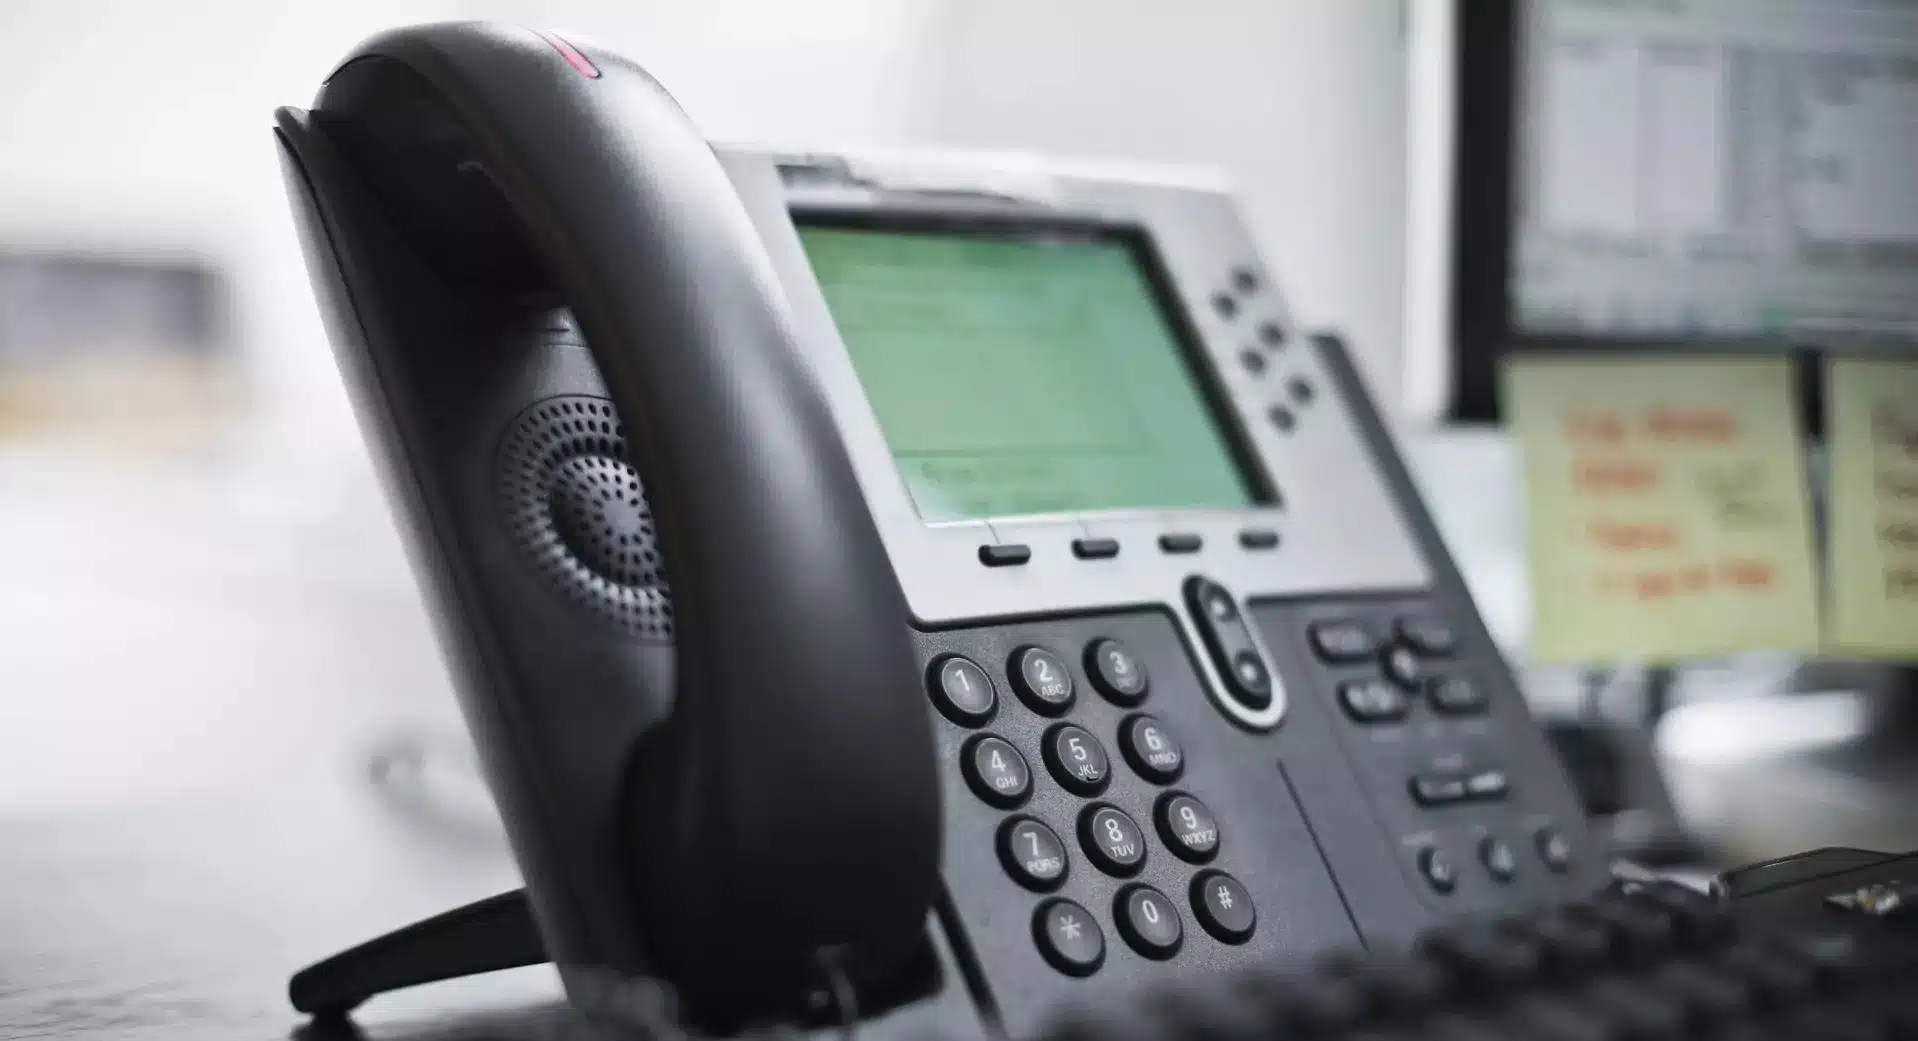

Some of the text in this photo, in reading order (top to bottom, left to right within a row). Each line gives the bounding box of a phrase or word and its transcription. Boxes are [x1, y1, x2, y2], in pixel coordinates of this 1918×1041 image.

[1034, 659, 1053, 682] 2
[1109, 651, 1128, 674] 3
[955, 669, 970, 692] 1
[1041, 684, 1064, 697] ABC
[1068, 738, 1087, 761] 5
[1144, 727, 1161, 751] 6
[991, 750, 1006, 772] 4
[1078, 763, 1098, 776] JKL
[1180, 806, 1197, 829] 9
[1105, 818, 1123, 842] 8
[1181, 829, 1216, 845] WXYZ
[1023, 832, 1038, 856] 7
[1110, 843, 1135, 857] TUV
[1142, 900, 1158, 923] 0
